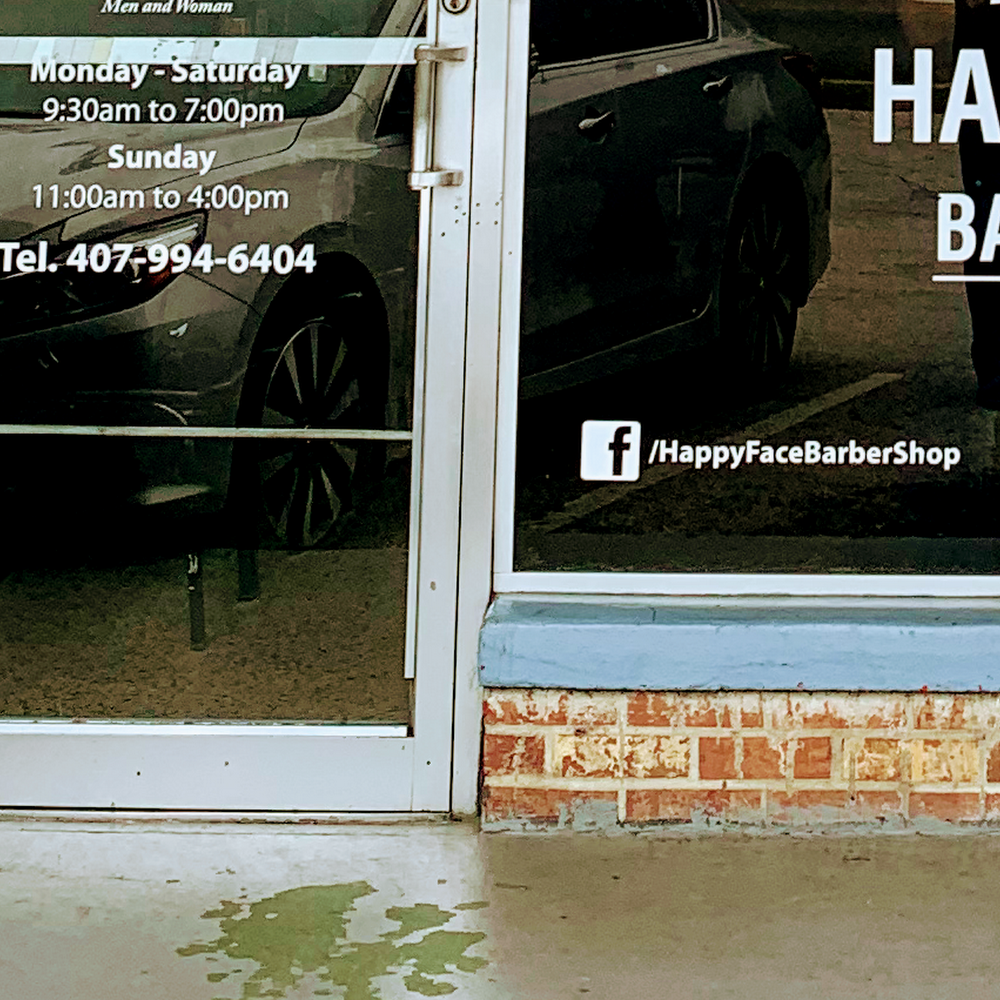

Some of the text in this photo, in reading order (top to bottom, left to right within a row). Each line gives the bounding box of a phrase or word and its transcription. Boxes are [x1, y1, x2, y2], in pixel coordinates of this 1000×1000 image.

[29, 60, 148, 89] Monday
[171, 59, 302, 89] Saturday
[42, 98, 285, 129] 9:30am to 7:00pm
[107, 144, 217, 176] Sunday
[32, 184, 289, 216] 11:00am to 4:00pm
[0, 241, 317, 275] Tel. 407-994-6404
[648, 439, 962, 471] /HappyFaceBarberShop
